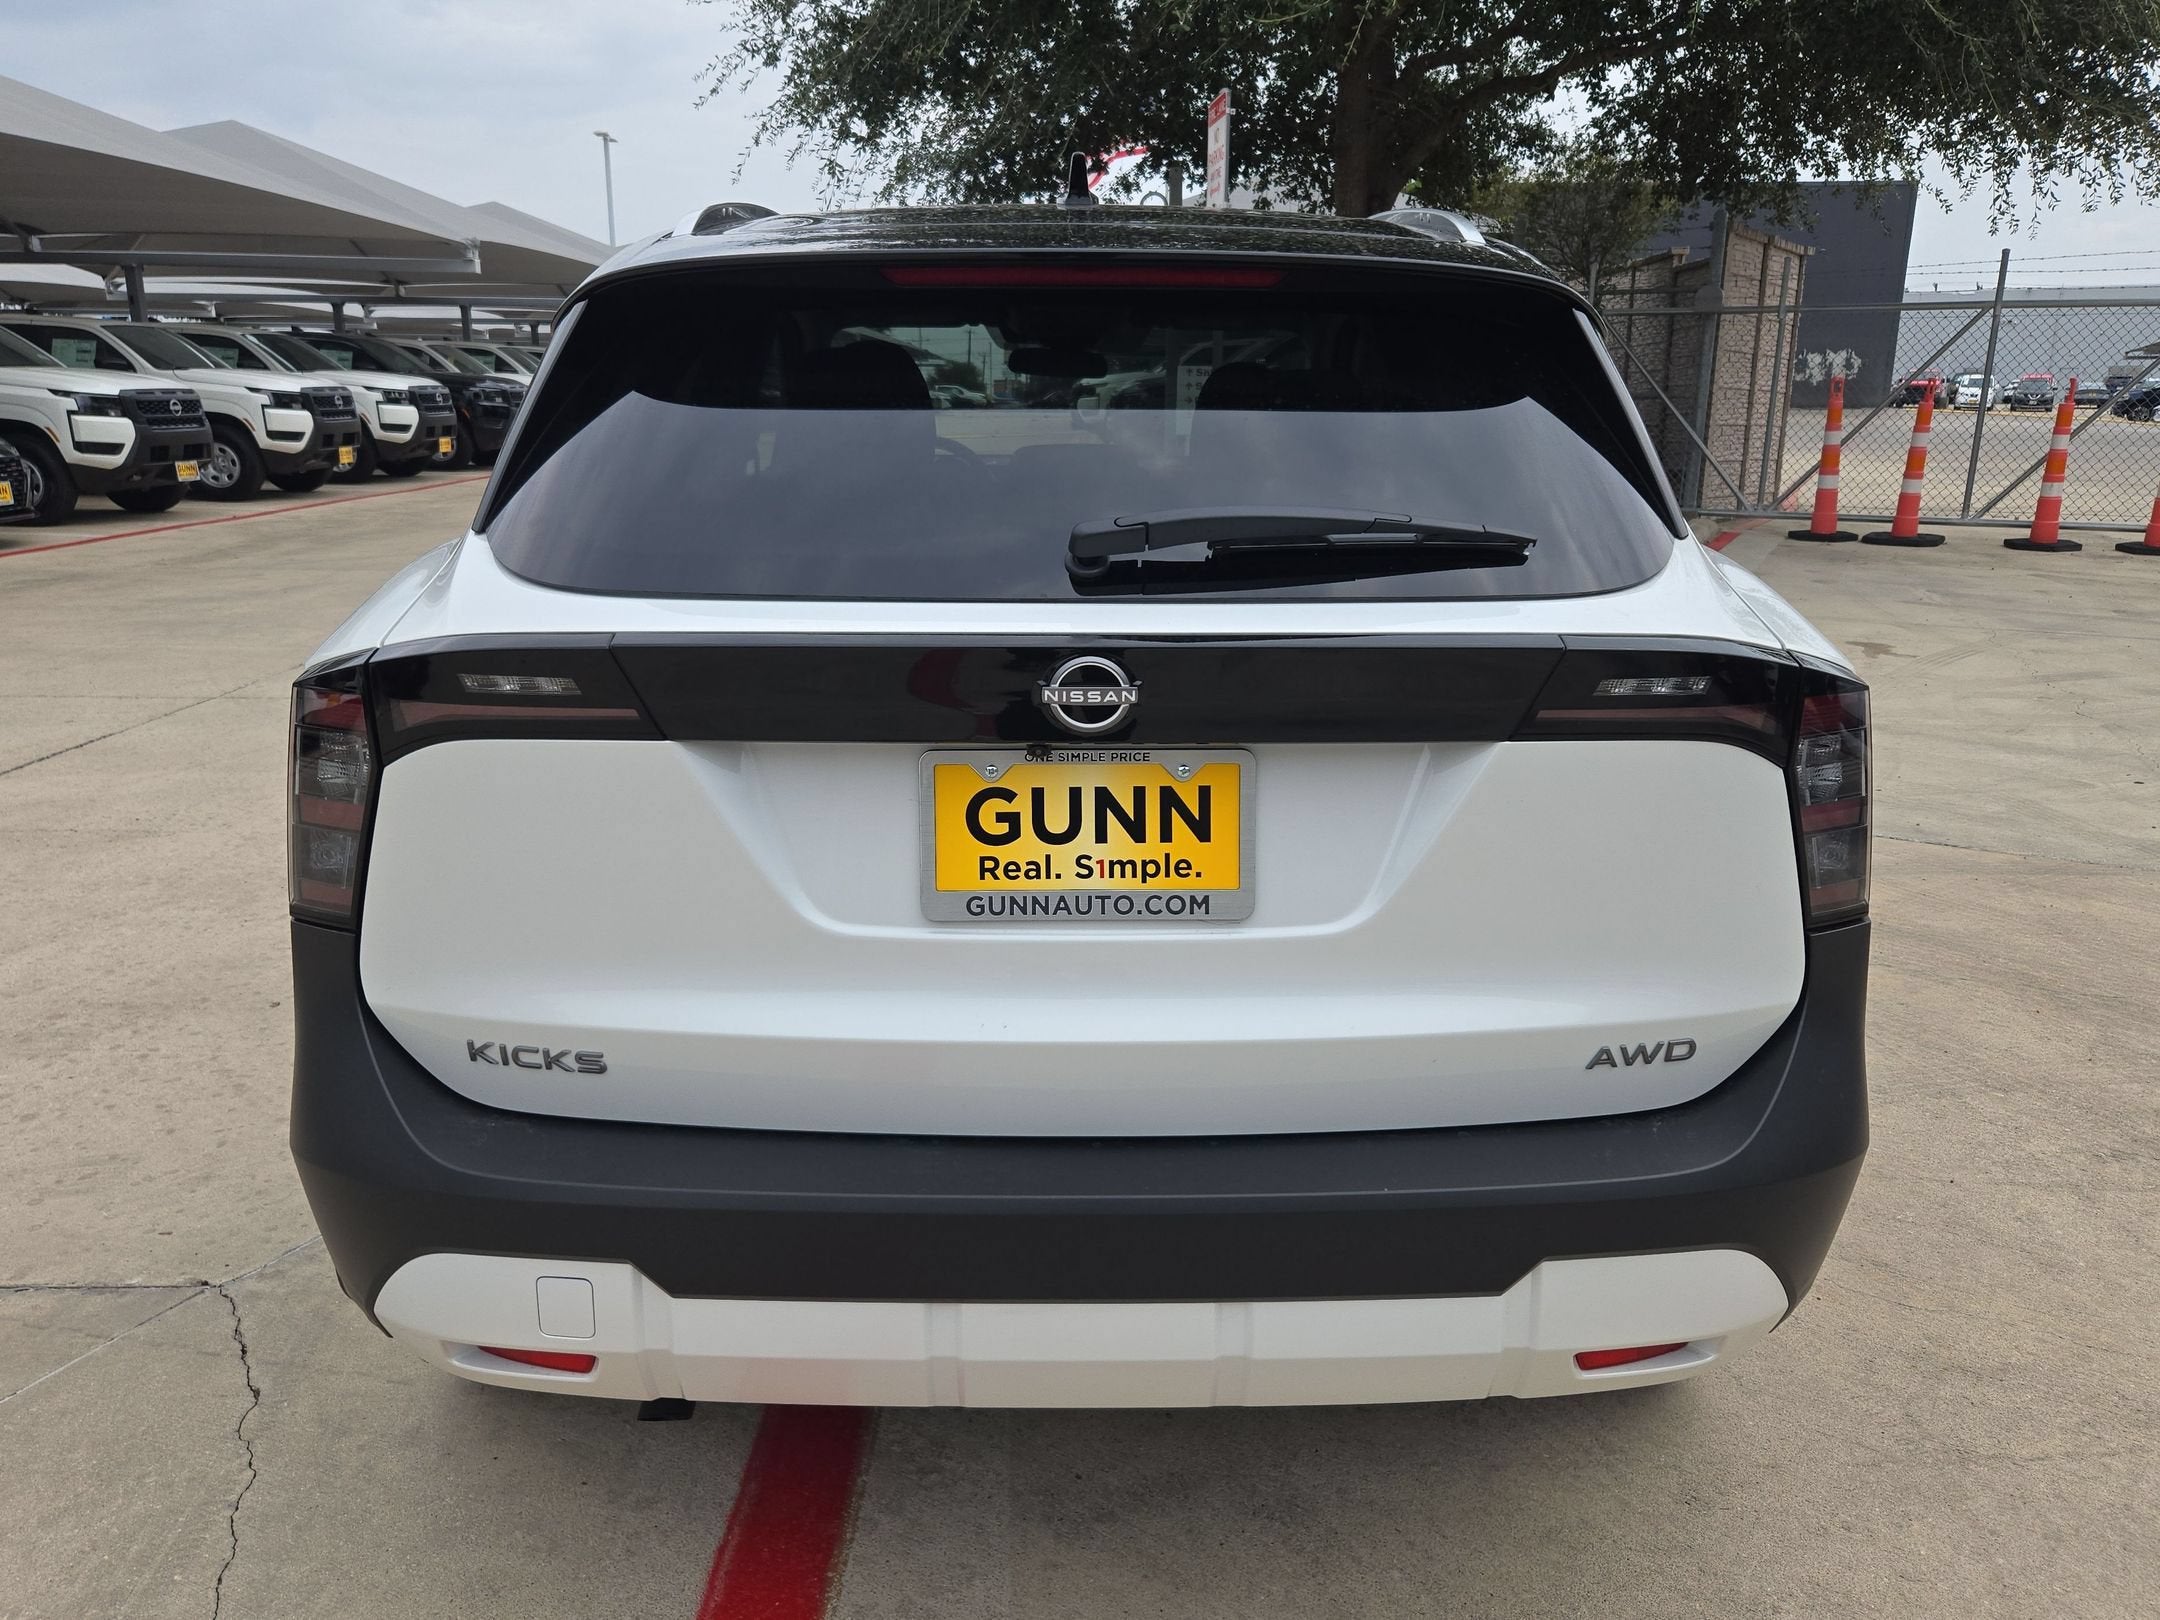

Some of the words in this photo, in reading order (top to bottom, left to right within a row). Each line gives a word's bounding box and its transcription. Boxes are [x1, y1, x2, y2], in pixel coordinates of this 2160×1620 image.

[1044, 690, 1136, 703] NISSAN
[1058, 752, 1106, 762] SIMPLE
[1110, 752, 1151, 762] PRICE
[965, 785, 1212, 846] GUNN
[978, 854, 1062, 881] Real.
[965, 894, 1211, 916] GUNNAUTO.COM
[466, 1038, 608, 1075] KICKS
[1584, 1037, 1697, 1070] AWD
